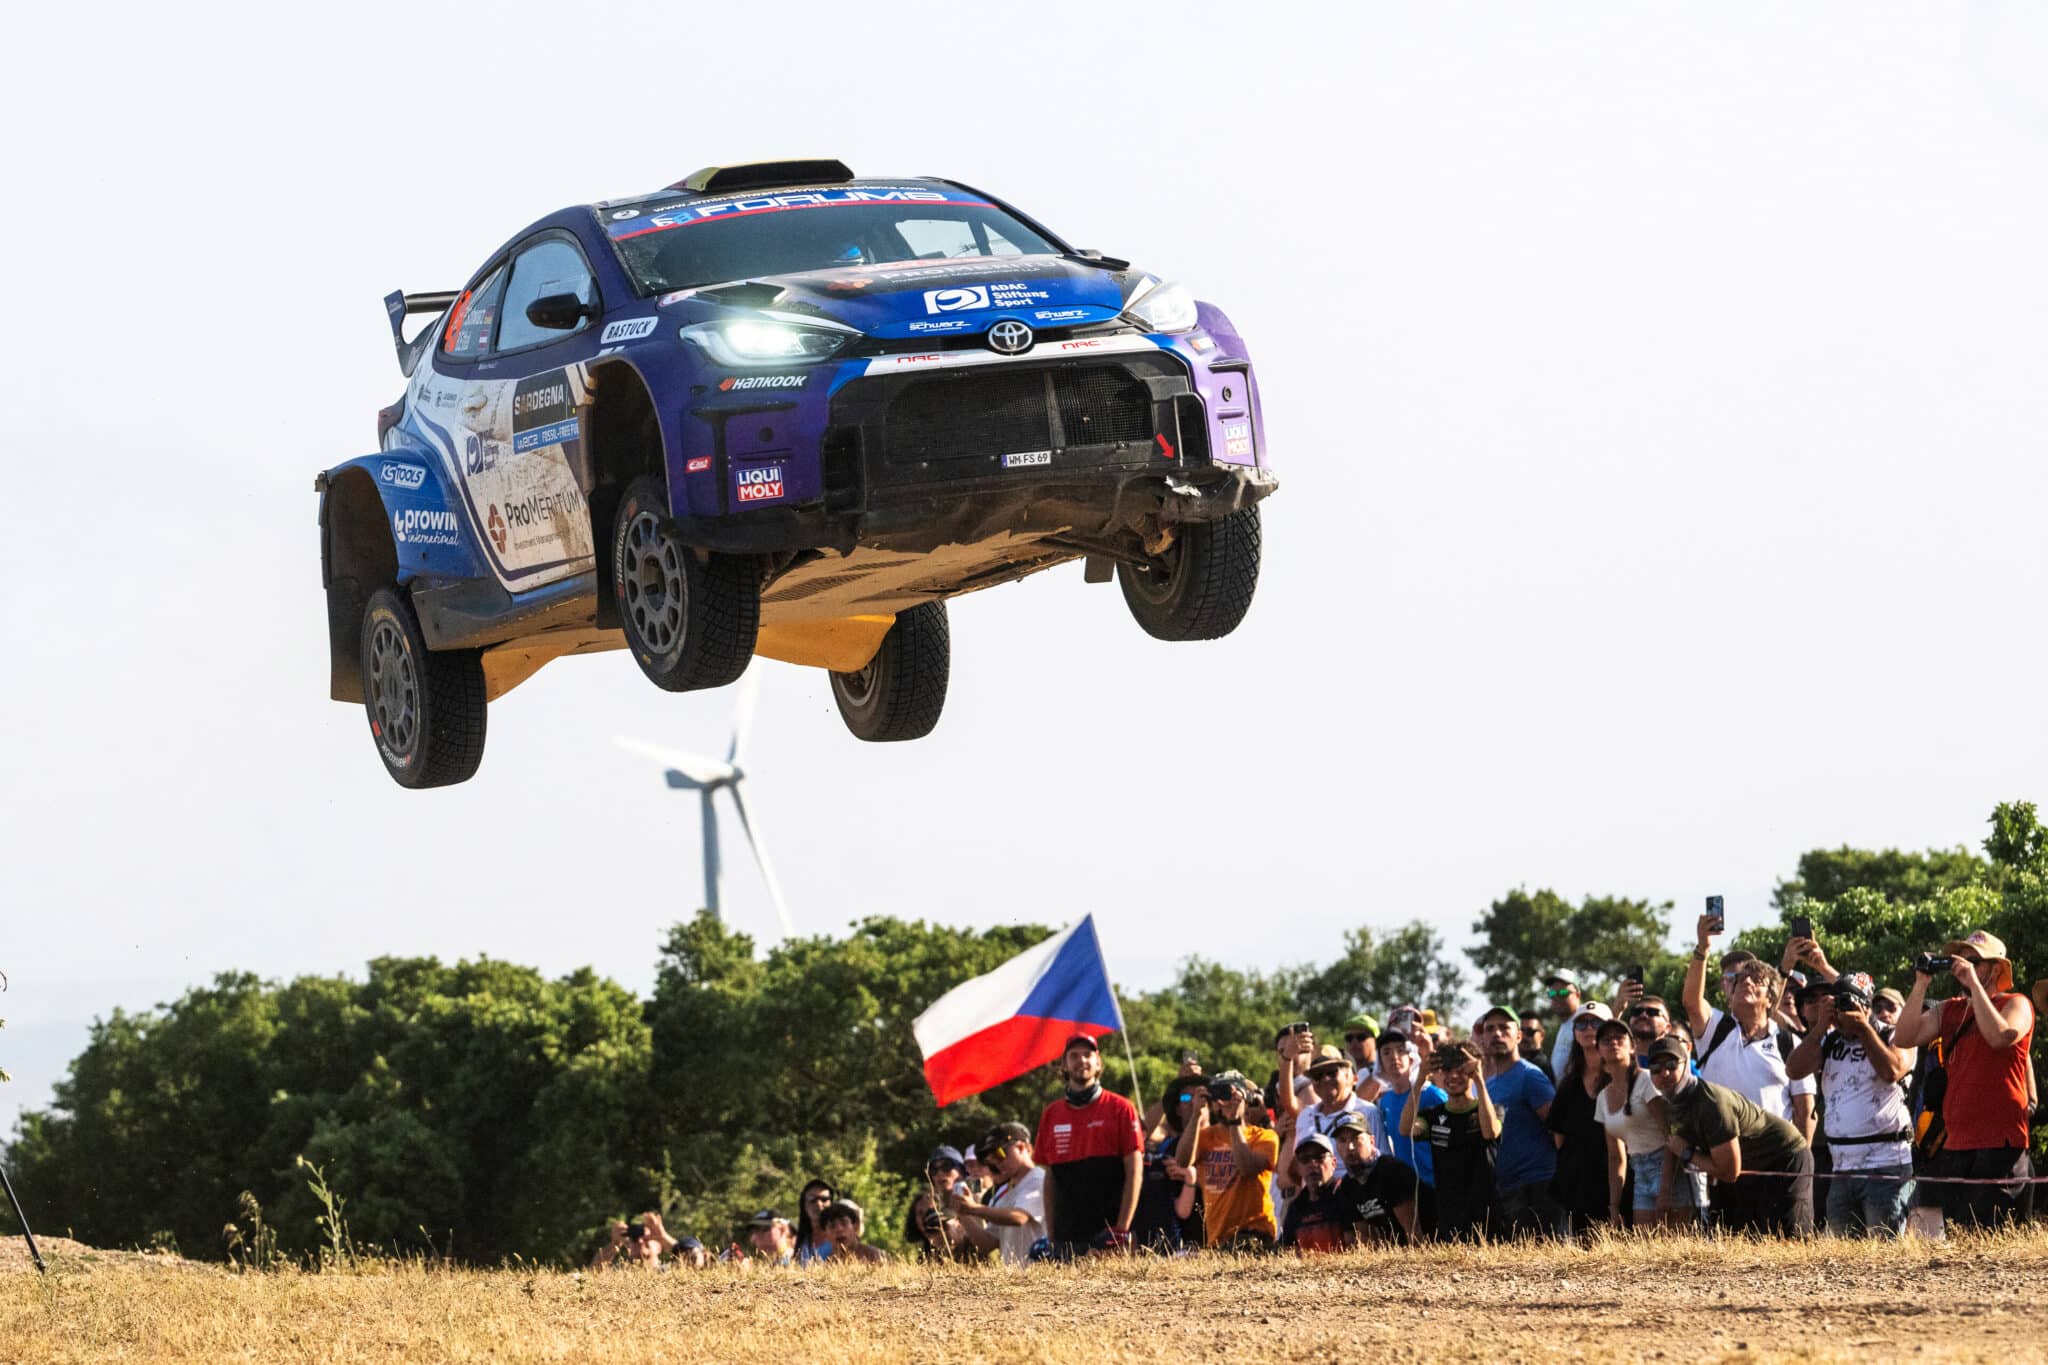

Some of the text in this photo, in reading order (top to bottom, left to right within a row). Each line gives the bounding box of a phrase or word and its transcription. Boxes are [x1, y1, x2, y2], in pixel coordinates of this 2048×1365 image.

[990, 283, 1028, 292] ADAC
[992, 290, 1050, 299] Stiftung
[994, 298, 1035, 308] Sport
[606, 320, 651, 340] BASTUCK
[1009, 452, 1048, 465] WM FS 69
[738, 468, 779, 485] LIQUI
[740, 482, 781, 500] MOLY
